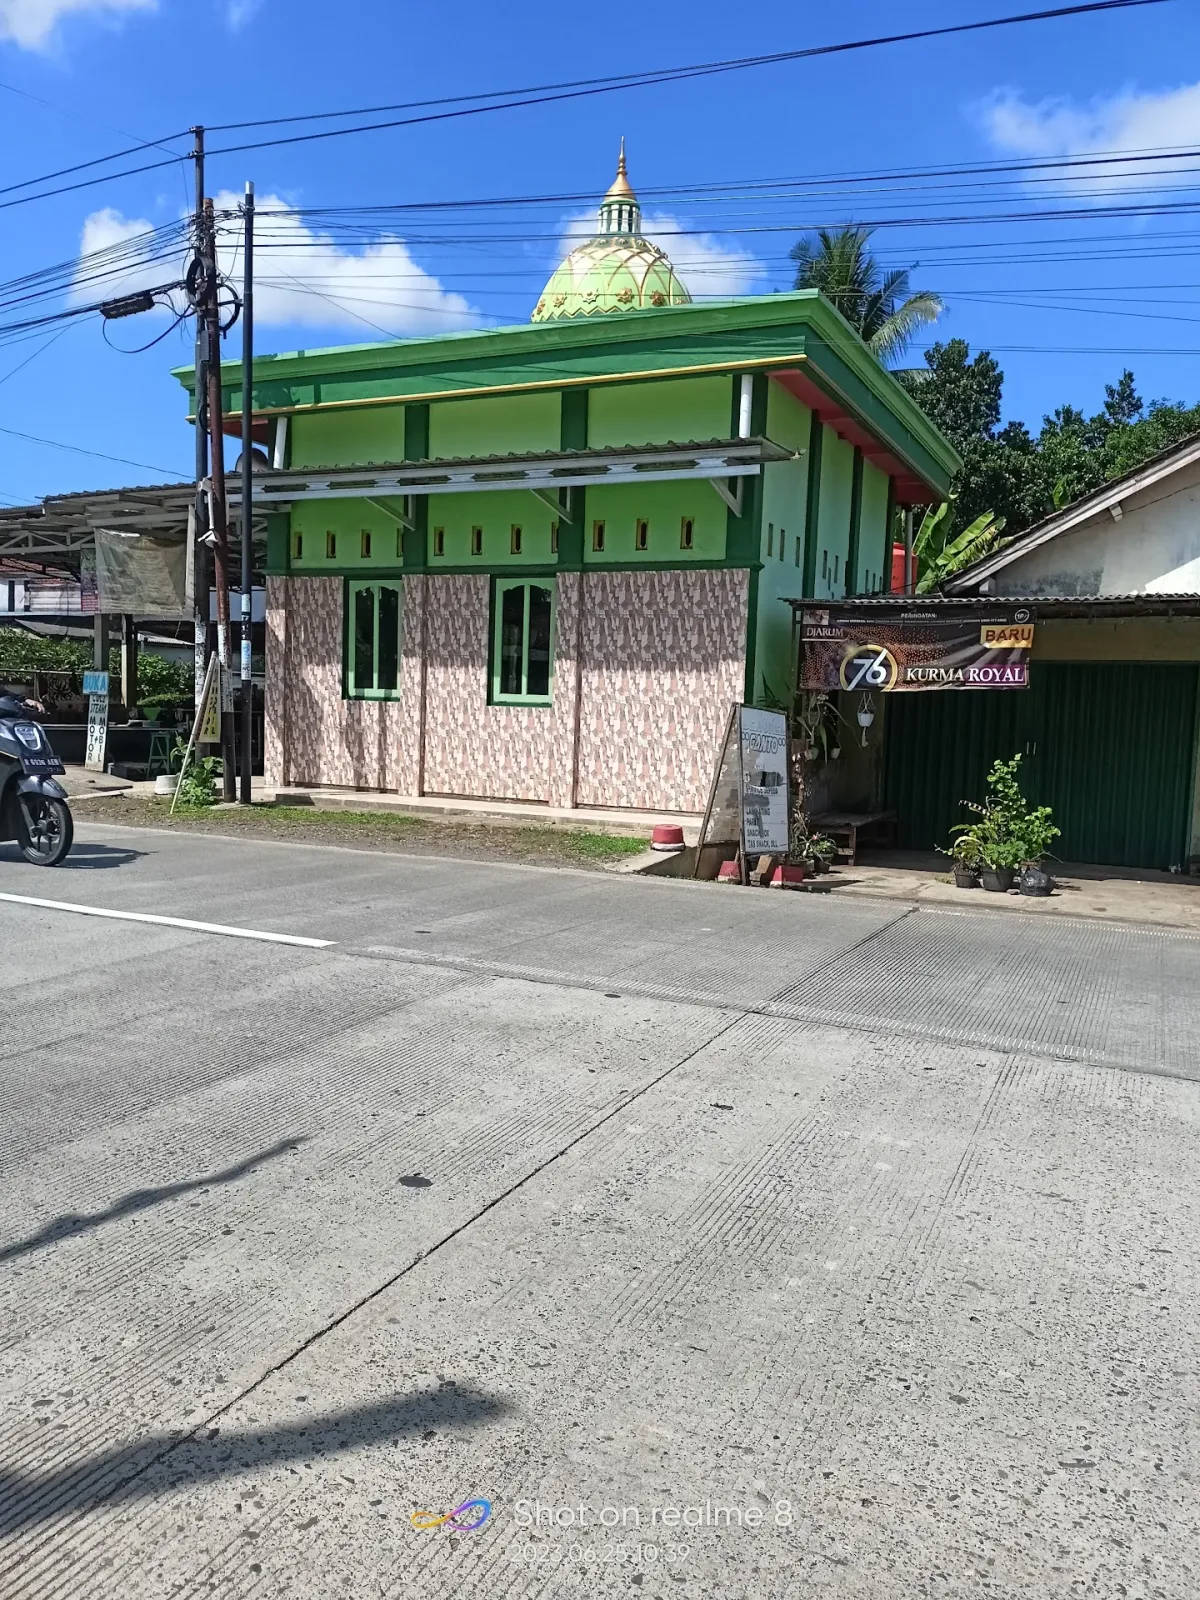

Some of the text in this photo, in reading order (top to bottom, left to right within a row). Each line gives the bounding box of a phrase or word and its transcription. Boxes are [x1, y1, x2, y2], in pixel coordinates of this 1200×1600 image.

[806, 627, 844, 637] DJARUM
[985, 628, 1032, 642] BARU
[847, 648, 888, 690] 76
[905, 667, 1025, 682] KURMA ROYAL
[88, 716, 96, 761] MOTOR
[98, 717, 106, 762] MOBIL
